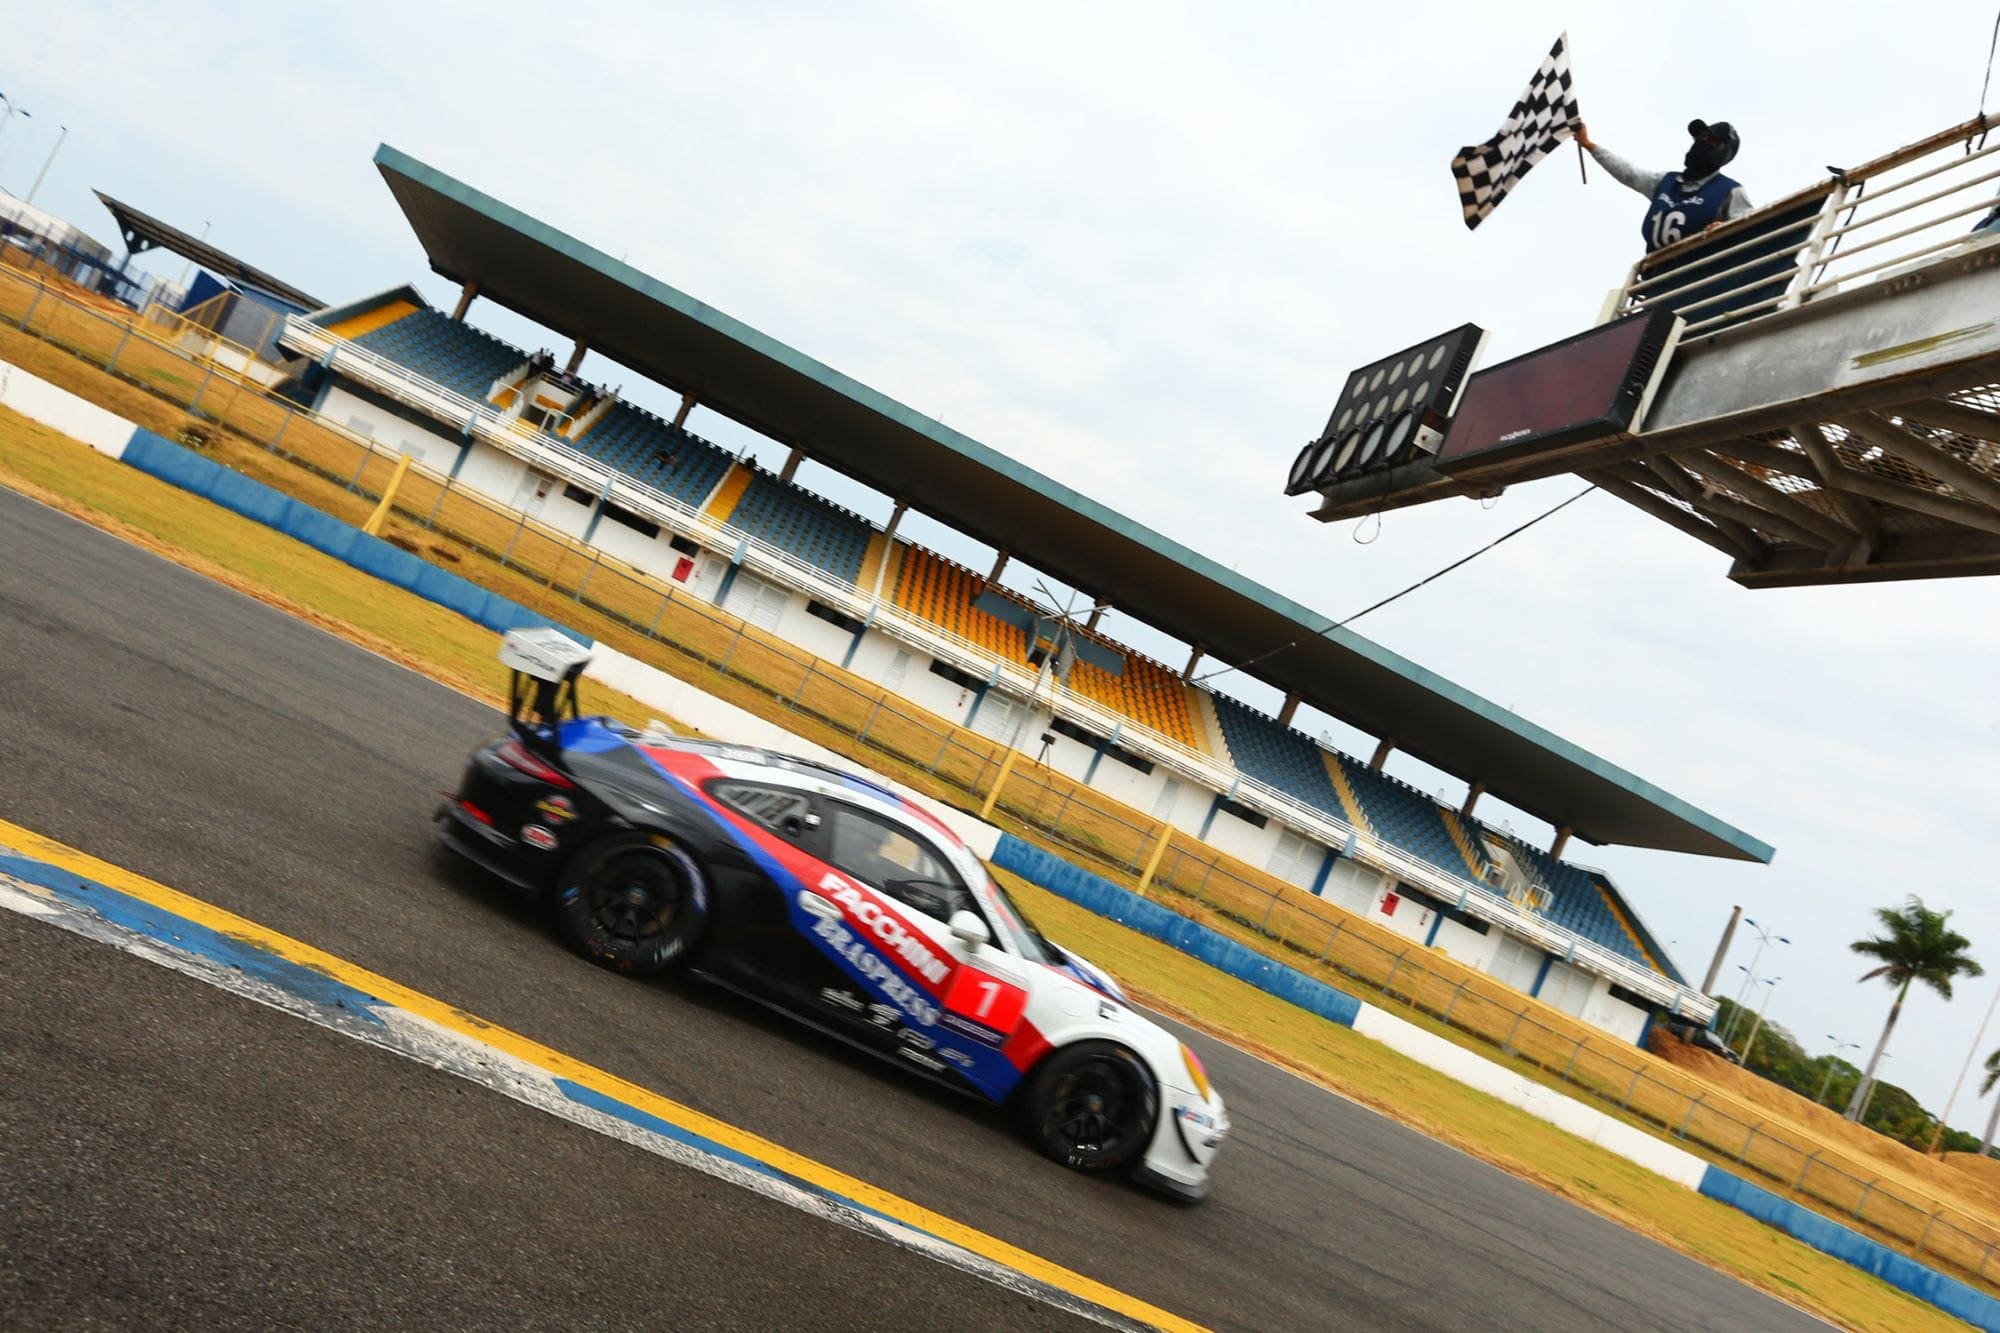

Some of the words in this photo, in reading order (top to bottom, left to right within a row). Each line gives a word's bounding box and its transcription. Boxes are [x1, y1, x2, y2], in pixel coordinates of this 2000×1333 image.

[1652, 211, 1686, 248] 16
[818, 872, 951, 984] FACCHINI
[977, 981, 1001, 1018] 1
